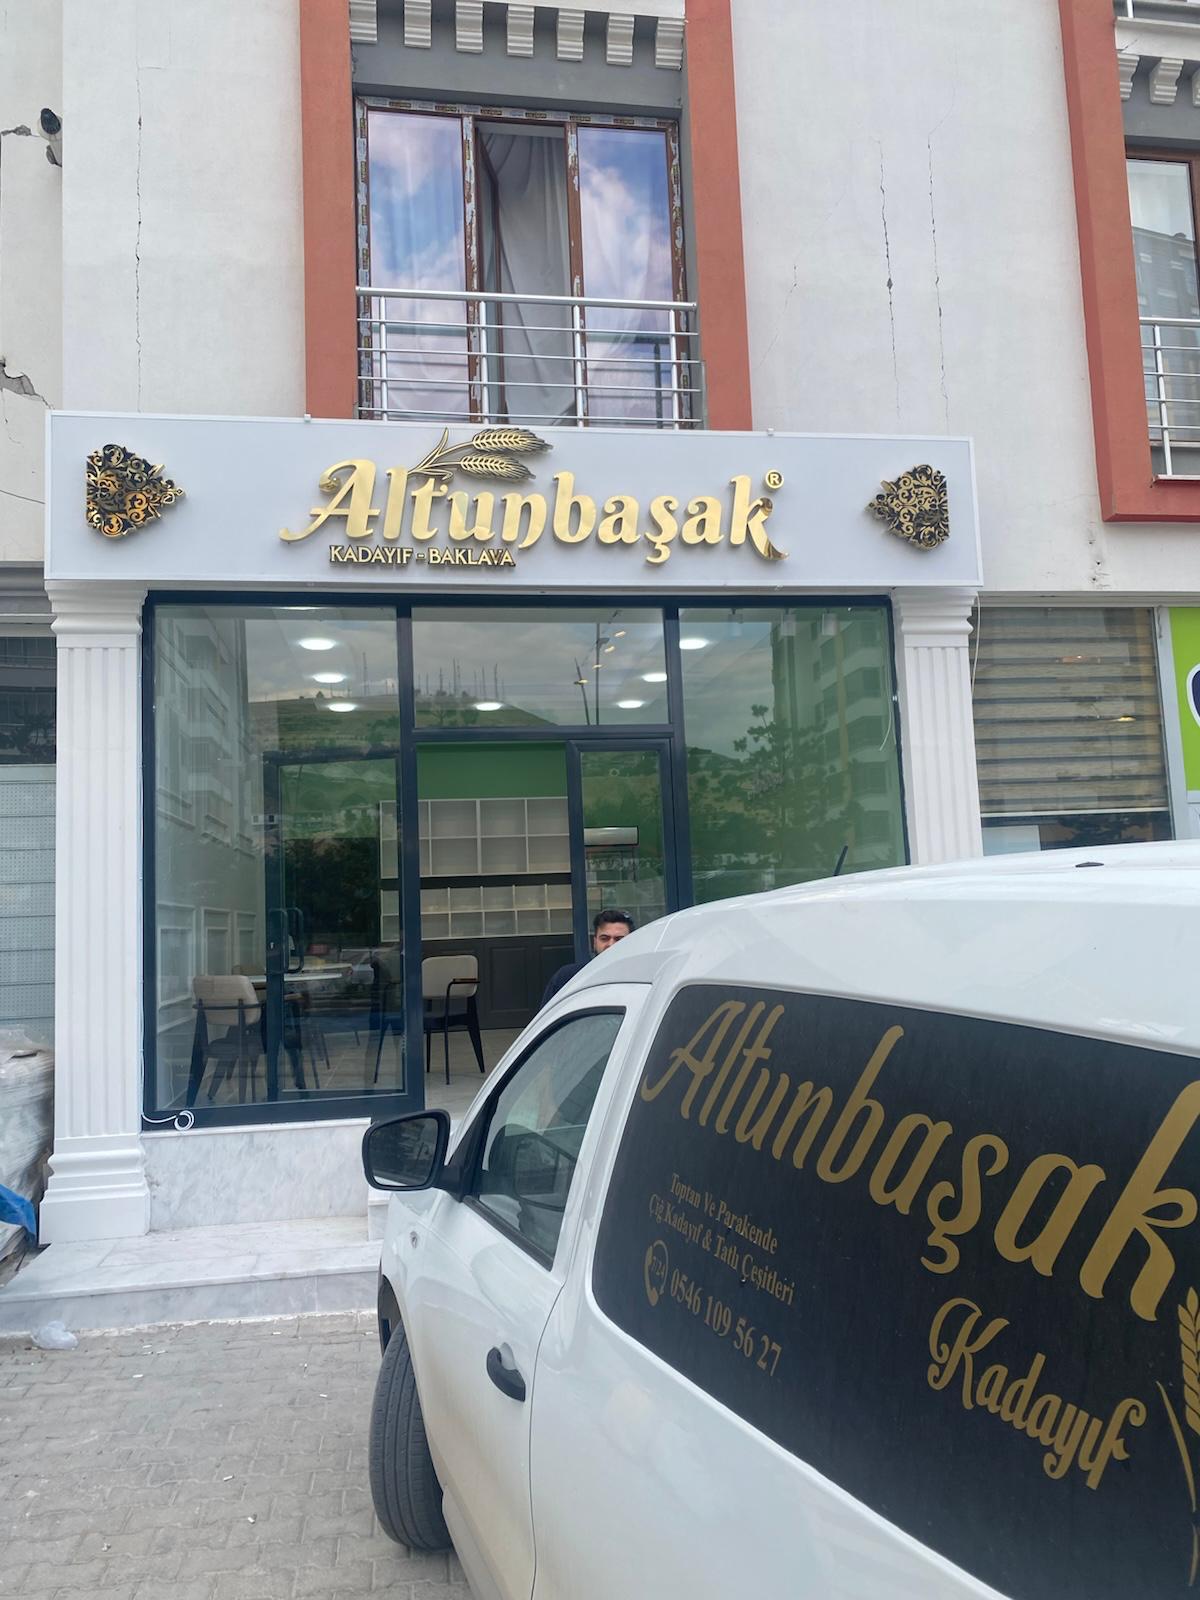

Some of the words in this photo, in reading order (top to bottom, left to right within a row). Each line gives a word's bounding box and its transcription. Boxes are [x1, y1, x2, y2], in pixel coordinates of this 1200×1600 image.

[279, 459, 789, 564] Altunbaşak
[329, 545, 413, 567] KADAYIF
[428, 548, 516, 567] BAKLAVA
[641, 1000, 1200, 1322] Altunbaşak
[663, 1201, 704, 1244] Kadayıf
[702, 1228, 713, 1252] &
[714, 1235, 740, 1271] Tatlı
[741, 1253, 796, 1306] Çeşitleri
[671, 1173, 701, 1209] Toptan
[704, 1191, 716, 1217] Ve
[716, 1199, 778, 1255] Parakende
[670, 1268, 702, 1315] 0546
[704, 1295, 732, 1337] 109
[733, 1316, 756, 1358] 56
[757, 1334, 782, 1377] 27
[927, 1297, 1147, 1490] Kadayıf
